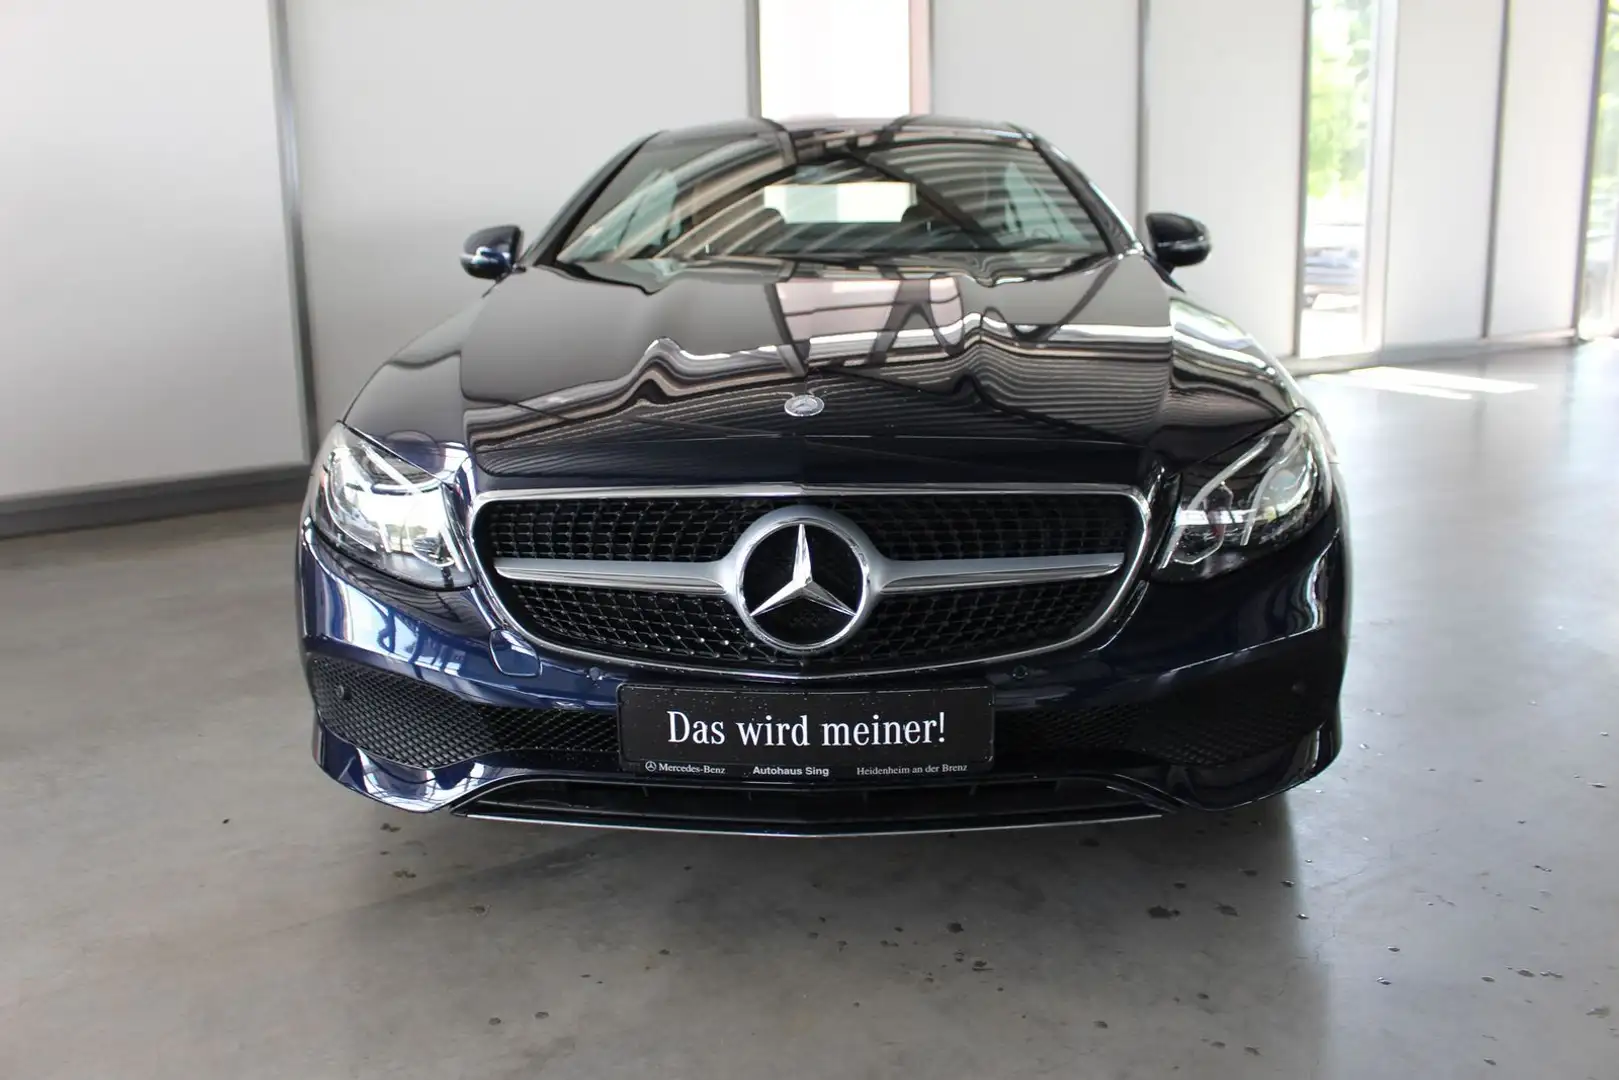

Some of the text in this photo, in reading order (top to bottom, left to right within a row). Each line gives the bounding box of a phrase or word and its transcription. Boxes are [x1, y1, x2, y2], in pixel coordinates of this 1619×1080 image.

[667, 711, 945, 747] Das wird meiner!
[658, 762, 726, 774] Mercedes-Benz
[752, 766, 830, 778] Autohaus Sing
[856, 766, 910, 776] Heidenheim
[924, 765, 940, 774] der
[942, 763, 968, 773] Brenz
